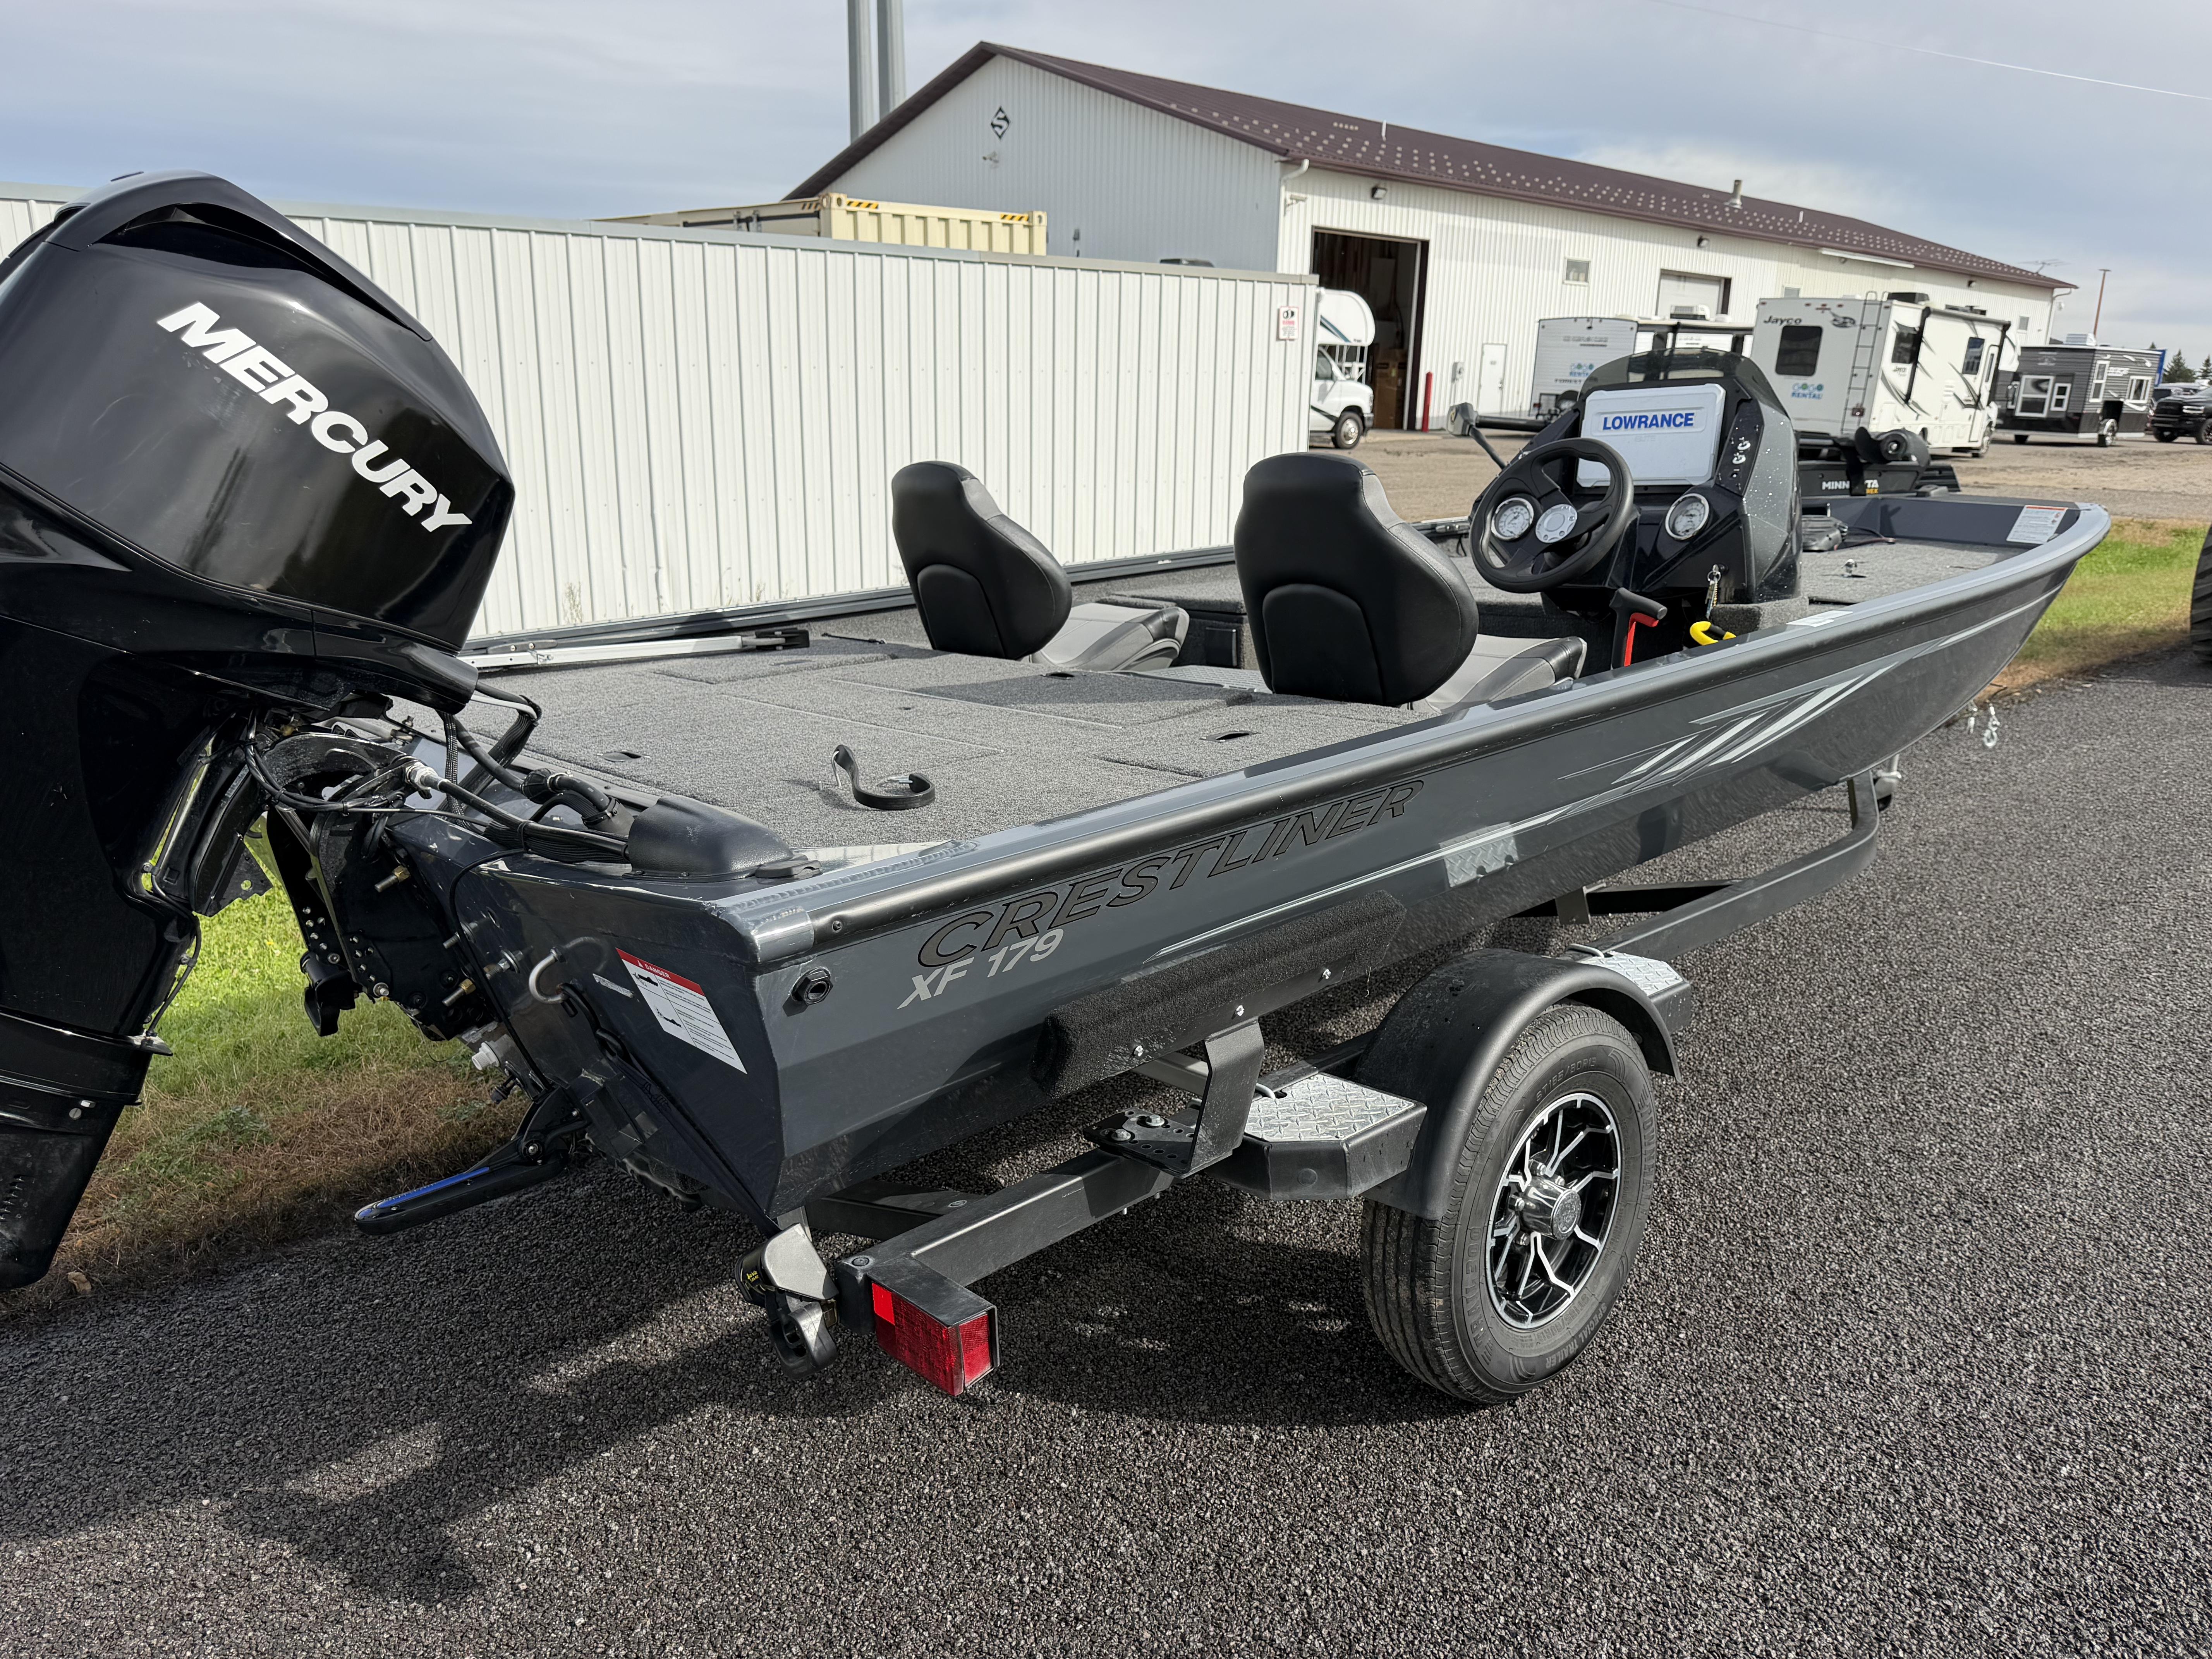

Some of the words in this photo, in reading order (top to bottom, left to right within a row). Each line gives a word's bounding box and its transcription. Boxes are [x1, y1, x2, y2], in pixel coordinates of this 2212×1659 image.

[1764, 316, 1802, 326] Jayco
[157, 302, 472, 532] MERCURY
[1602, 412, 1695, 430] LOWRANCE
[1822, 481, 1850, 490] MINN
[917, 779, 1424, 967] CRESTLINER
[645, 964, 671, 979] DANGER
[898, 958, 973, 1009] XF
[988, 928, 1065, 979] 179
[1579, 1303, 1607, 1343] SPECIAL
[1545, 1339, 1579, 1369] TRAILER
